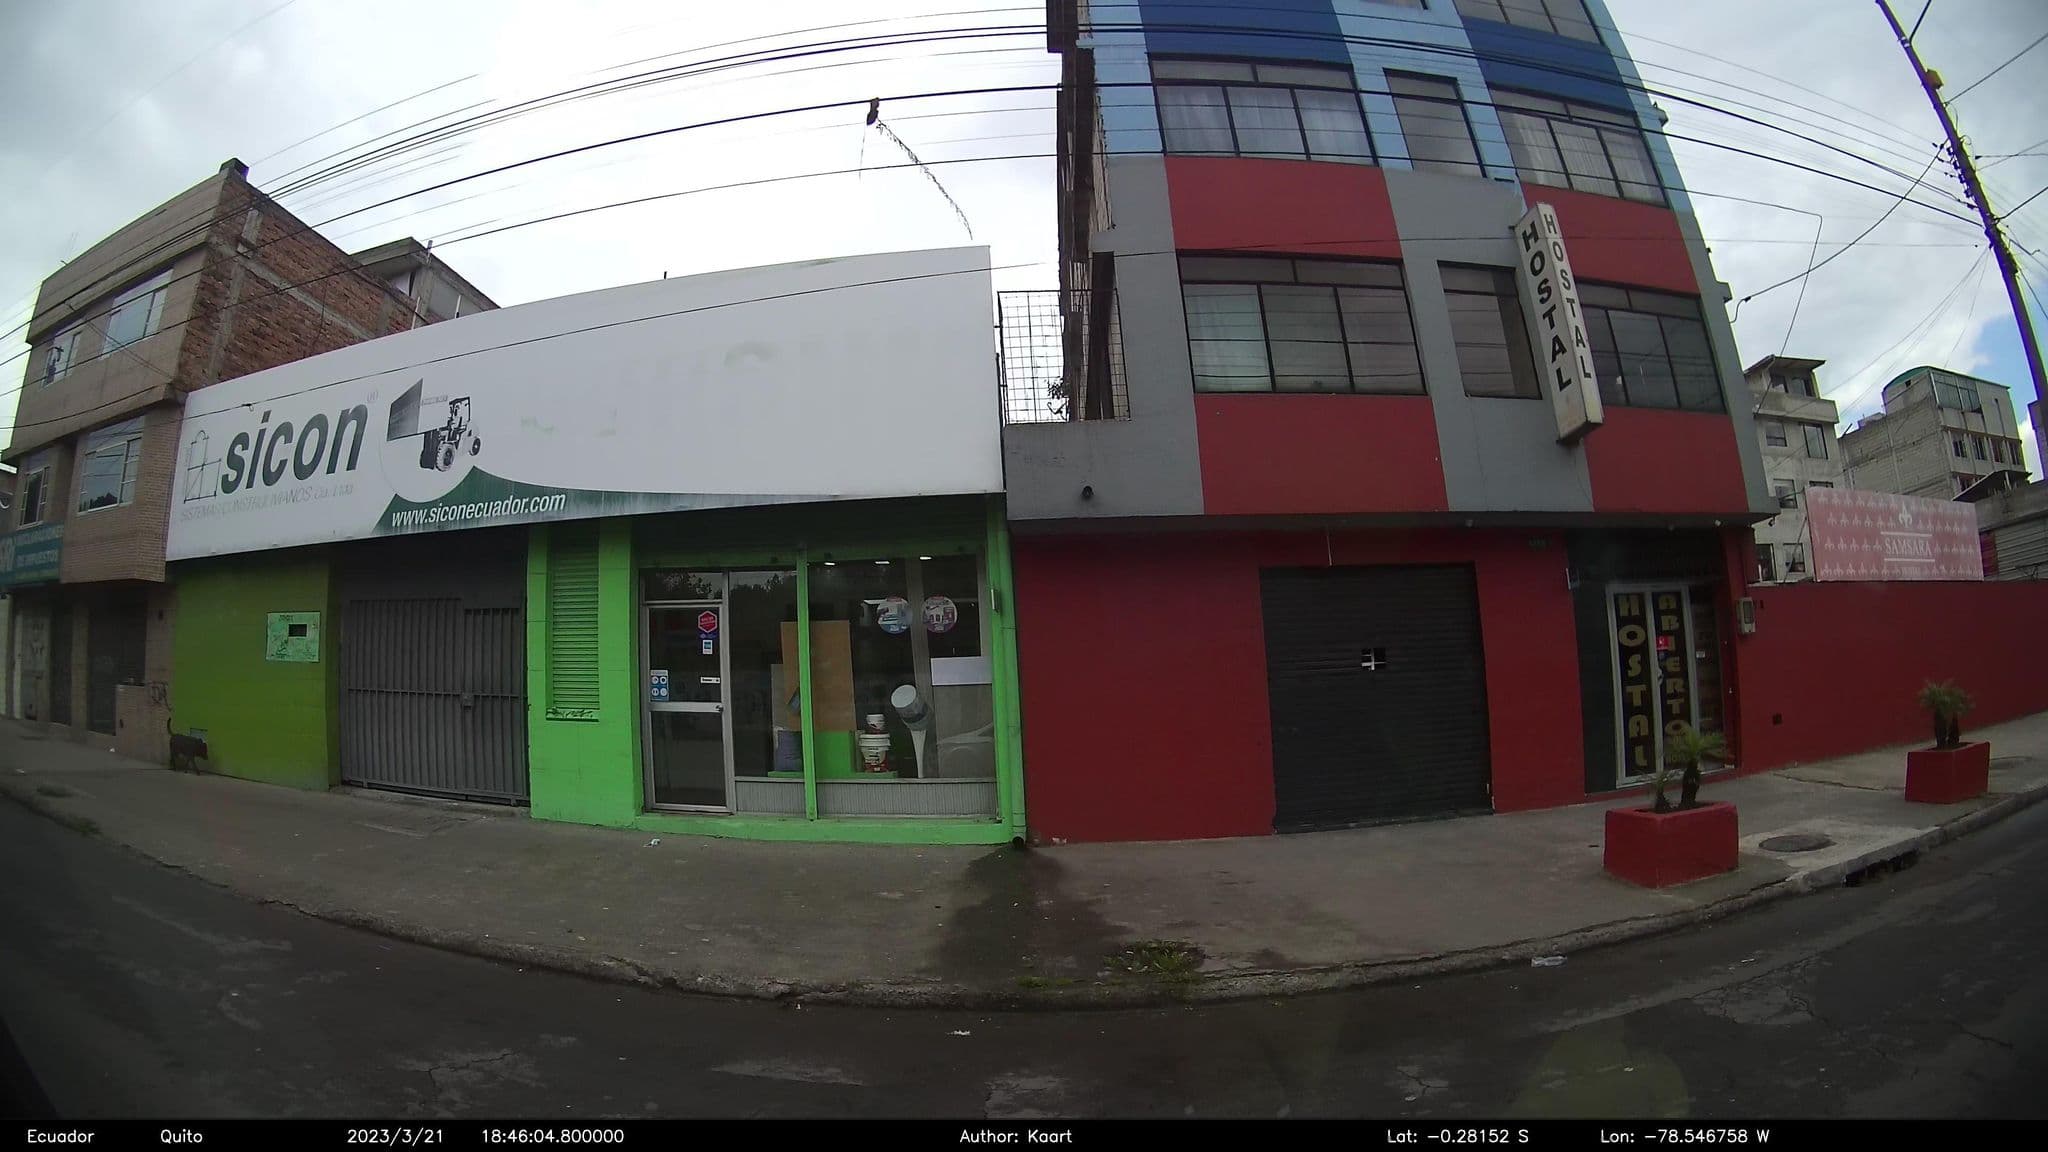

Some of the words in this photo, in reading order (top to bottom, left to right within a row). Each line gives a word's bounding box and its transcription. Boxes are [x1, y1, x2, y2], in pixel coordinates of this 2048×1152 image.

[1522, 221, 1572, 392] HOSTAL
[1543, 214, 1592, 378] HOSTAL
[221, 404, 368, 494] sicon
[392, 493, 567, 527] www.siconecuador.com
[1884, 537, 1933, 556] SAMSARA
[1618, 594, 1650, 767] HOSTAL
